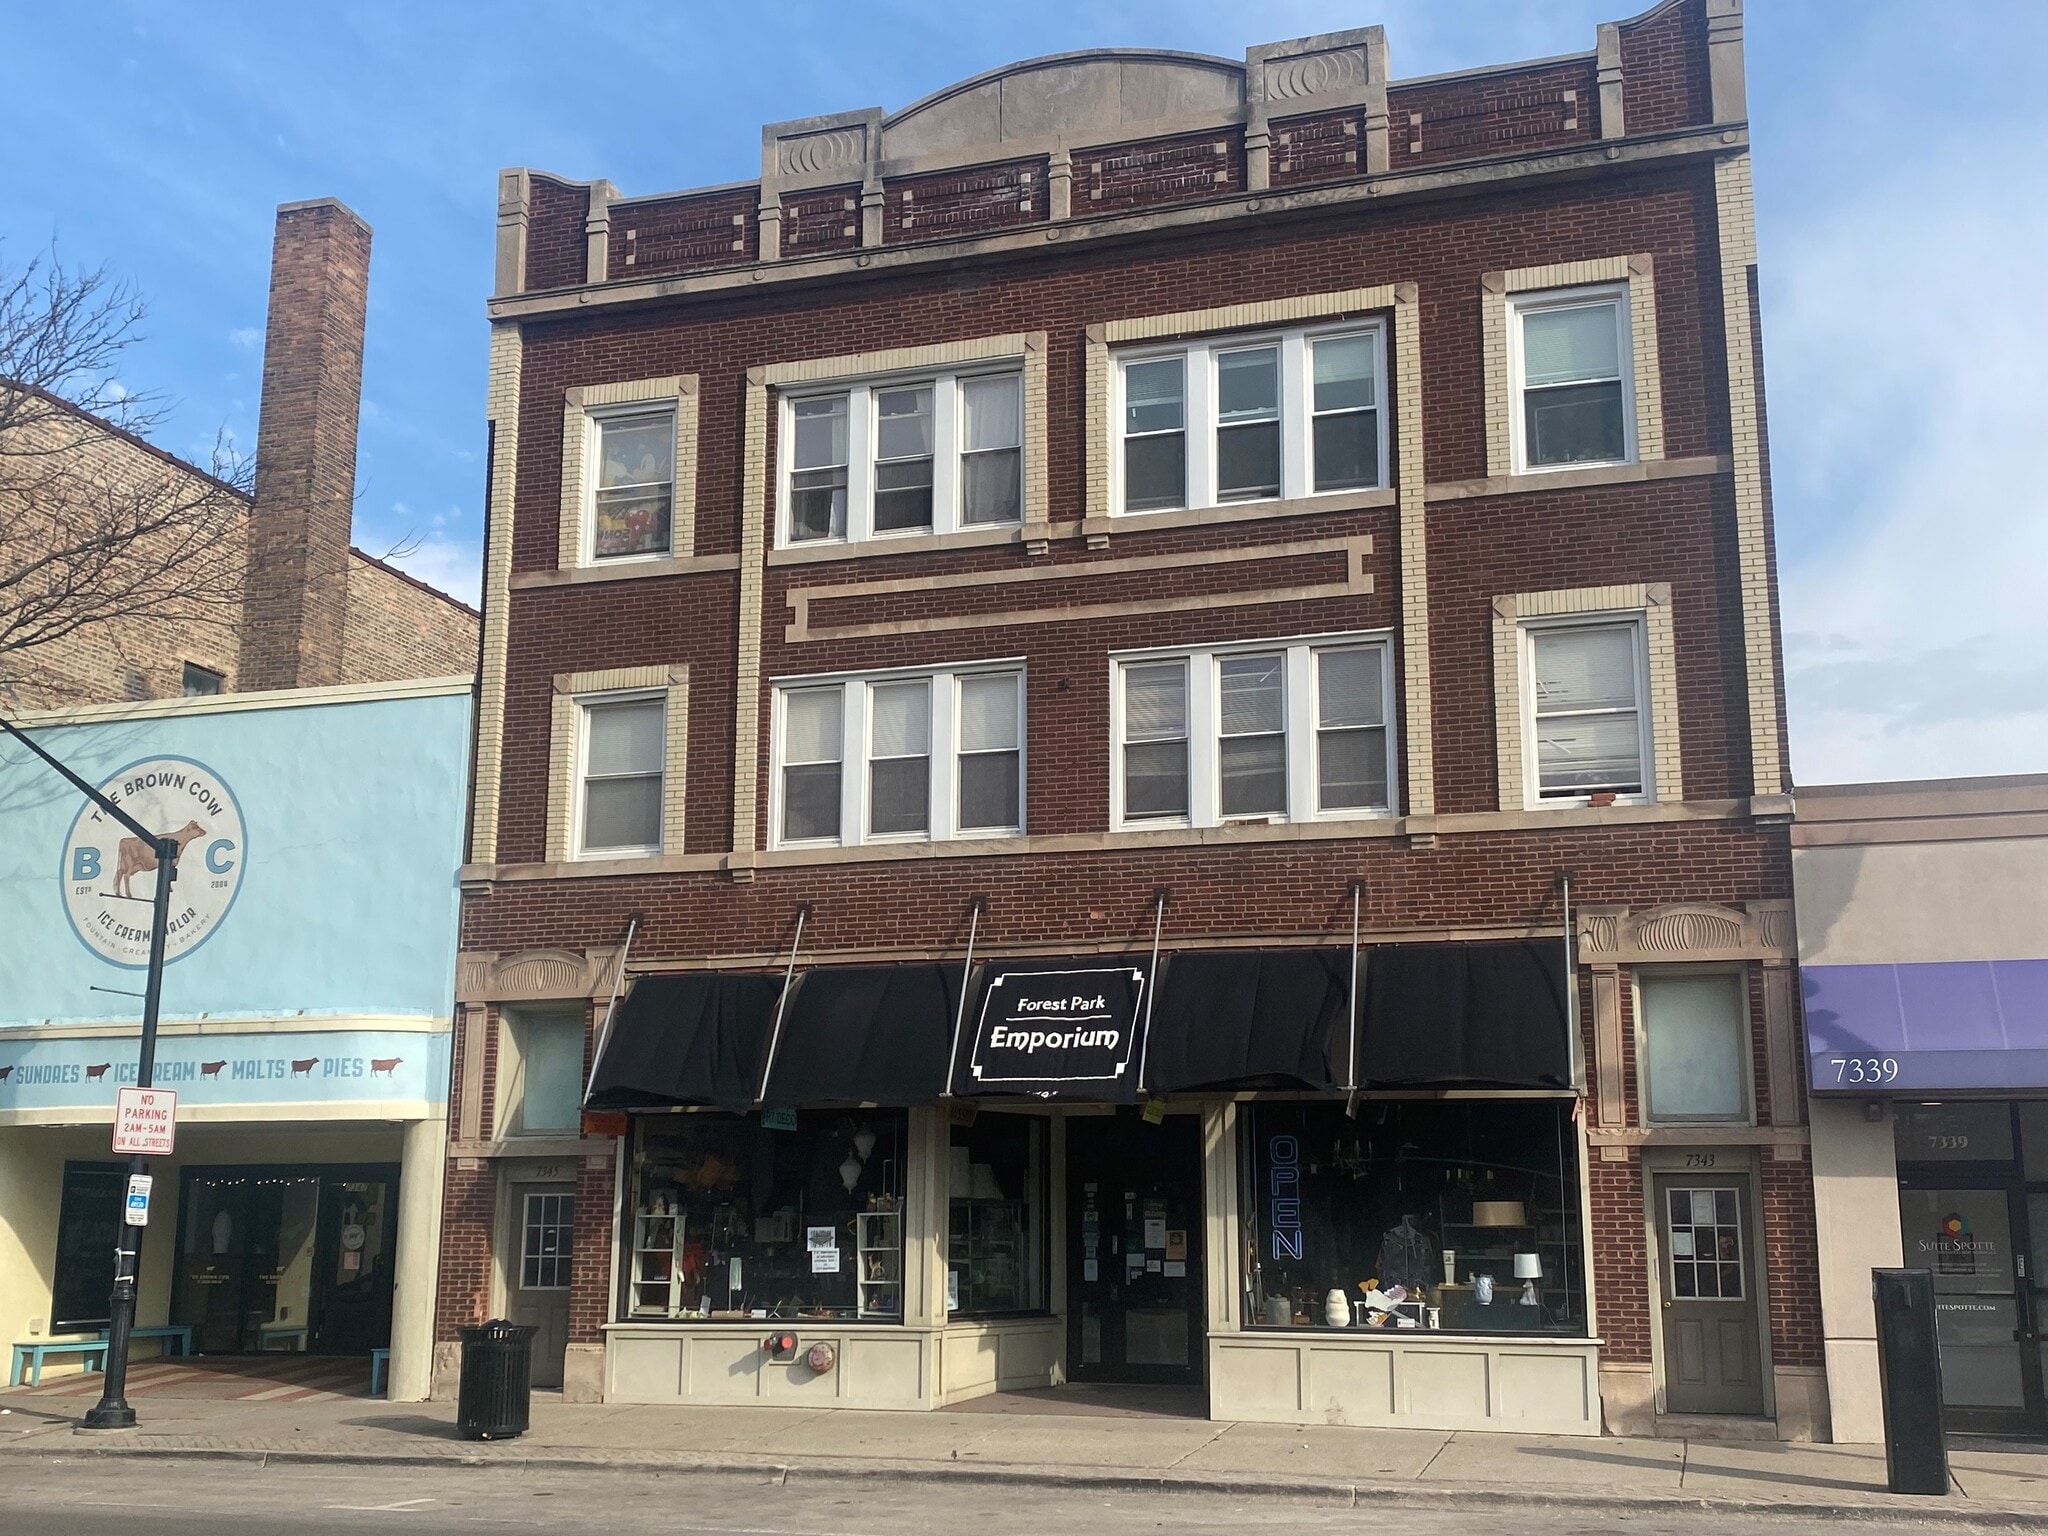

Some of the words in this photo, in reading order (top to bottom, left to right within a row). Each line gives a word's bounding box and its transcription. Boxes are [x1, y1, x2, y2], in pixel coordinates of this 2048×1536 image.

[91, 791, 121, 823] TE
[124, 773, 186, 797] BROWN
[189, 781, 222, 816] COW
[72, 846, 101, 880] B
[205, 838, 236, 875] C
[83, 917, 116, 949] FOUNTAIN
[179, 913, 210, 943] BAKERY
[97, 910, 115, 930] ICE
[114, 920, 150, 943] CREAM
[164, 907, 196, 937] RLOR
[1017, 998, 1067, 1012] Forest
[1070, 995, 1105, 1011] Park
[990, 1026, 1120, 1054] Emporium
[16, 1064, 80, 1084] SUNDAES
[114, 1063, 138, 1082] ICE
[153, 1061, 196, 1082] REAM
[232, 1059, 285, 1080] MALTS
[323, 1057, 364, 1078] PIES
[1831, 1058, 1898, 1083] 7339
[141, 1094, 154, 1105] NO
[125, 1107, 167, 1120] PARKING
[124, 1123, 166, 1134] 2AM-5AM
[116, 1137, 126, 1145] ON
[129, 1137, 140, 1147] ALL
[143, 1137, 170, 1148] STREETS
[1928, 1135, 1968, 1149] 7339
[1685, 1154, 1715, 1167] 7343
[1269, 1135, 1302, 1260] OPEN
